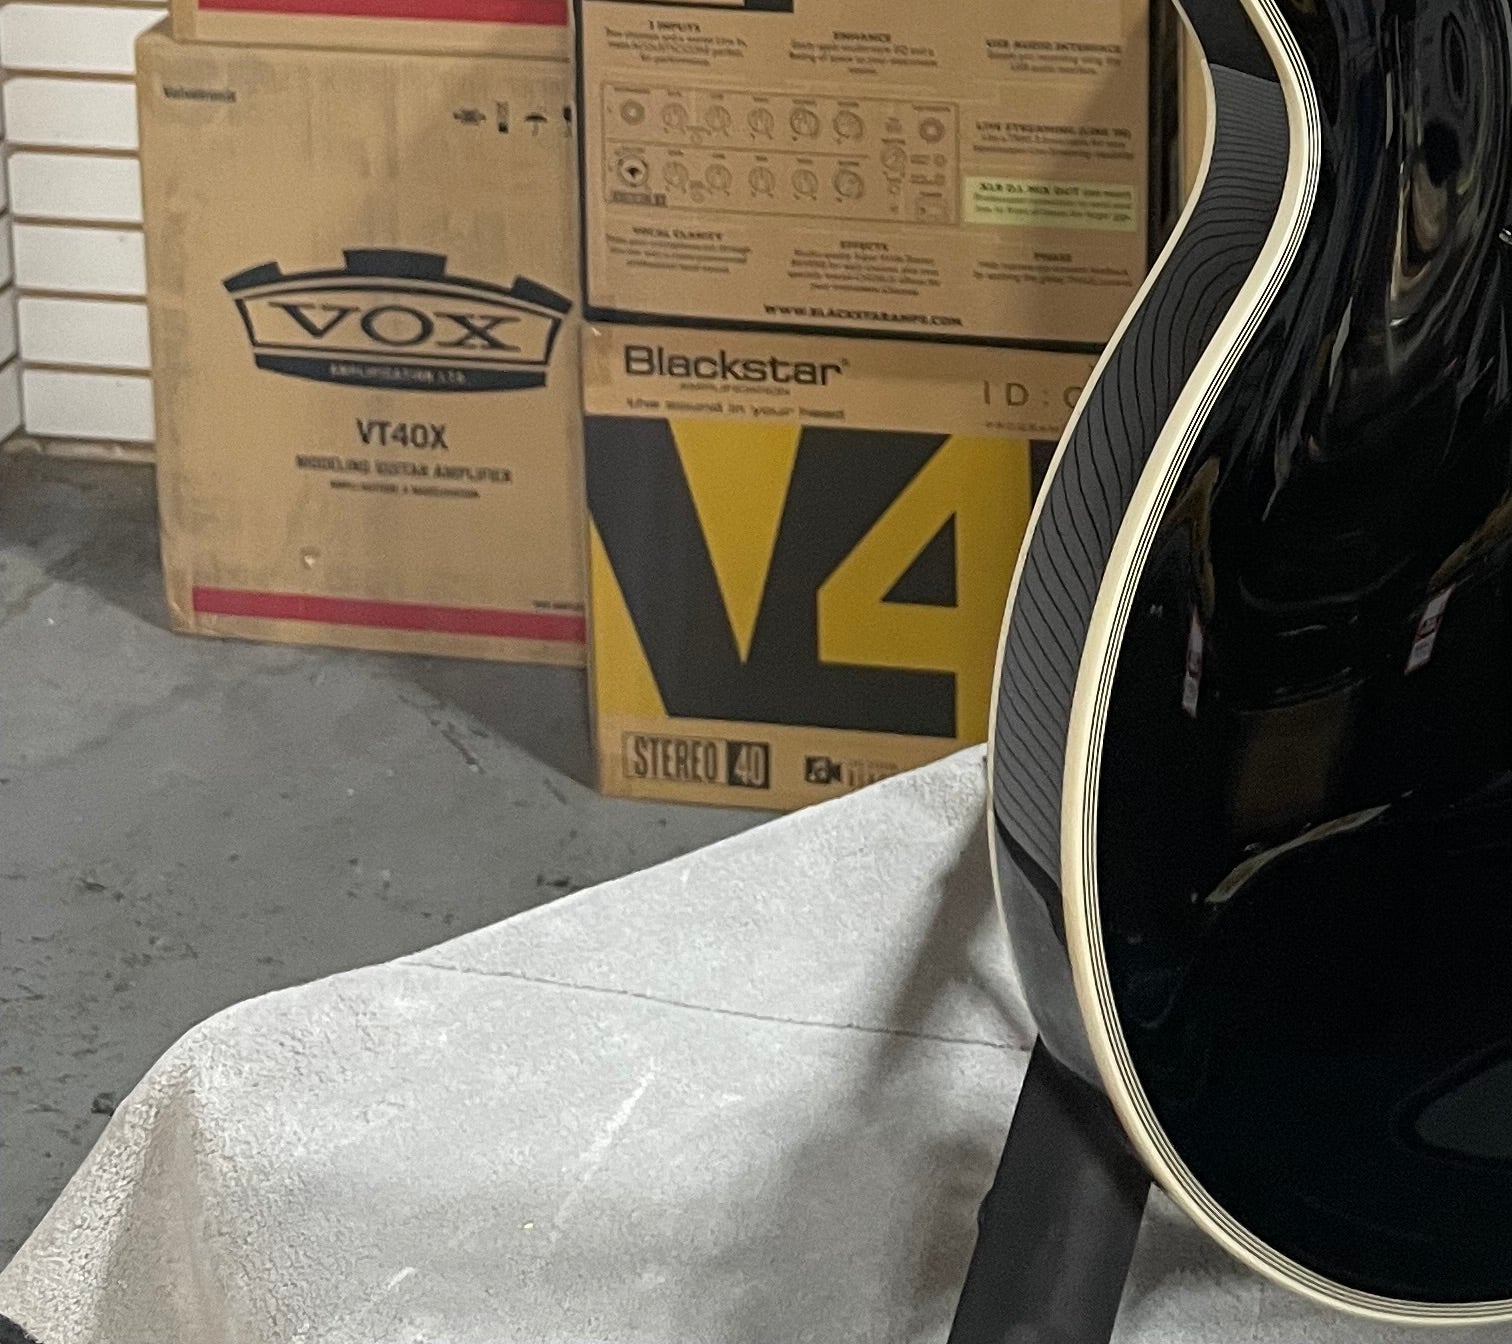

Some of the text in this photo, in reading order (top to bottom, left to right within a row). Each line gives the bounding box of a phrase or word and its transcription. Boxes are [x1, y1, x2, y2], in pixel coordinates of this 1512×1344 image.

[268, 301, 522, 353] VOX
[624, 344, 844, 387] Blackstar
[356, 417, 449, 450] VT40X
[633, 735, 767, 787] STEREO 40
